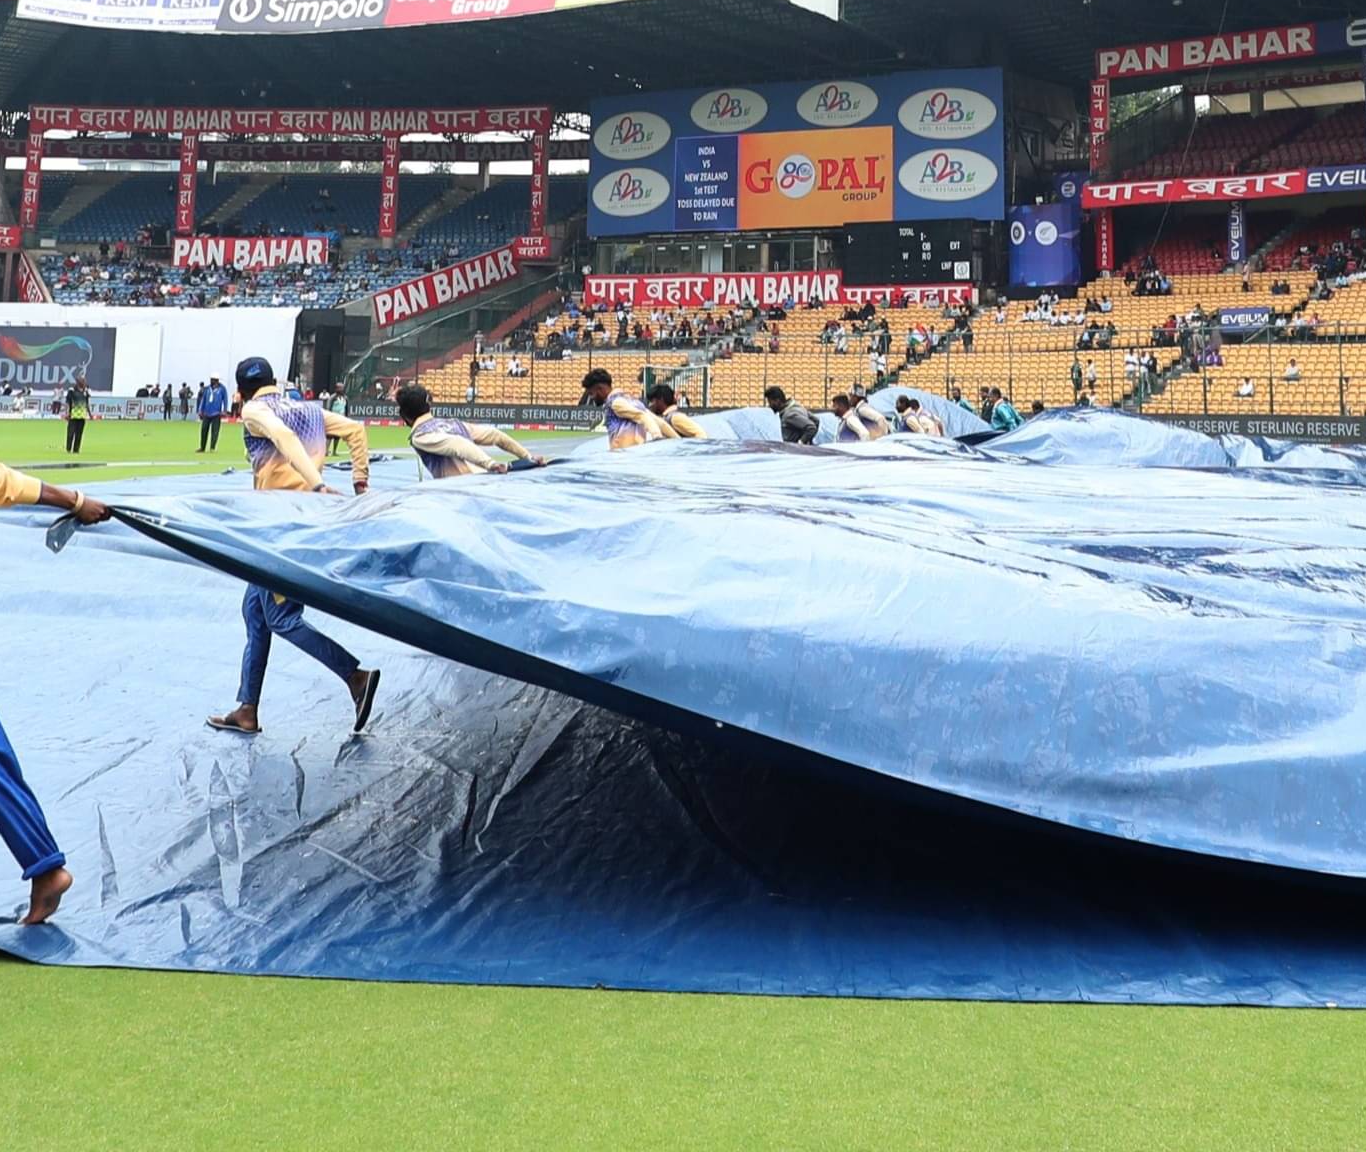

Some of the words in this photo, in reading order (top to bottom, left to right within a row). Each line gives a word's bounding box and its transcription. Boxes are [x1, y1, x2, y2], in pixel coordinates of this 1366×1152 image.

[1100, 45, 1168, 74] PAN
[1184, 26, 1312, 66] BAHAR
[920, 92, 964, 122] A2B
[134, 109, 170, 130] PAN
[173, 110, 231, 131] BAHAR
[332, 110, 366, 131] PAN
[369, 110, 428, 132] BAHAR
[698, 147, 715, 155] INDIA
[685, 174, 699, 182] NEW
[700, 173, 728, 181] ZEALAND
[920, 153, 965, 183] A2B
[703, 185, 718, 194] TEST
[842, 192, 877, 202] GROUP
[1089, 181, 1173, 201] पान
[677, 200, 692, 208] TOSS
[693, 199, 720, 208] DELAYED
[721, 199, 734, 207] DUE
[703, 212, 717, 220] RAIN
[175, 239, 224, 265] PAN
[234, 238, 327, 268] BAHAR
[377, 286, 429, 325] PAN
[435, 248, 517, 302] BAHAR
[714, 277, 756, 304] PAN
[763, 274, 839, 304] BAHAR
[473, 407, 516, 419] RESERVE
[522, 409, 568, 420] STERLING
[1247, 421, 1304, 435] STERLING
[1307, 422, 1360, 436] RESERVE
